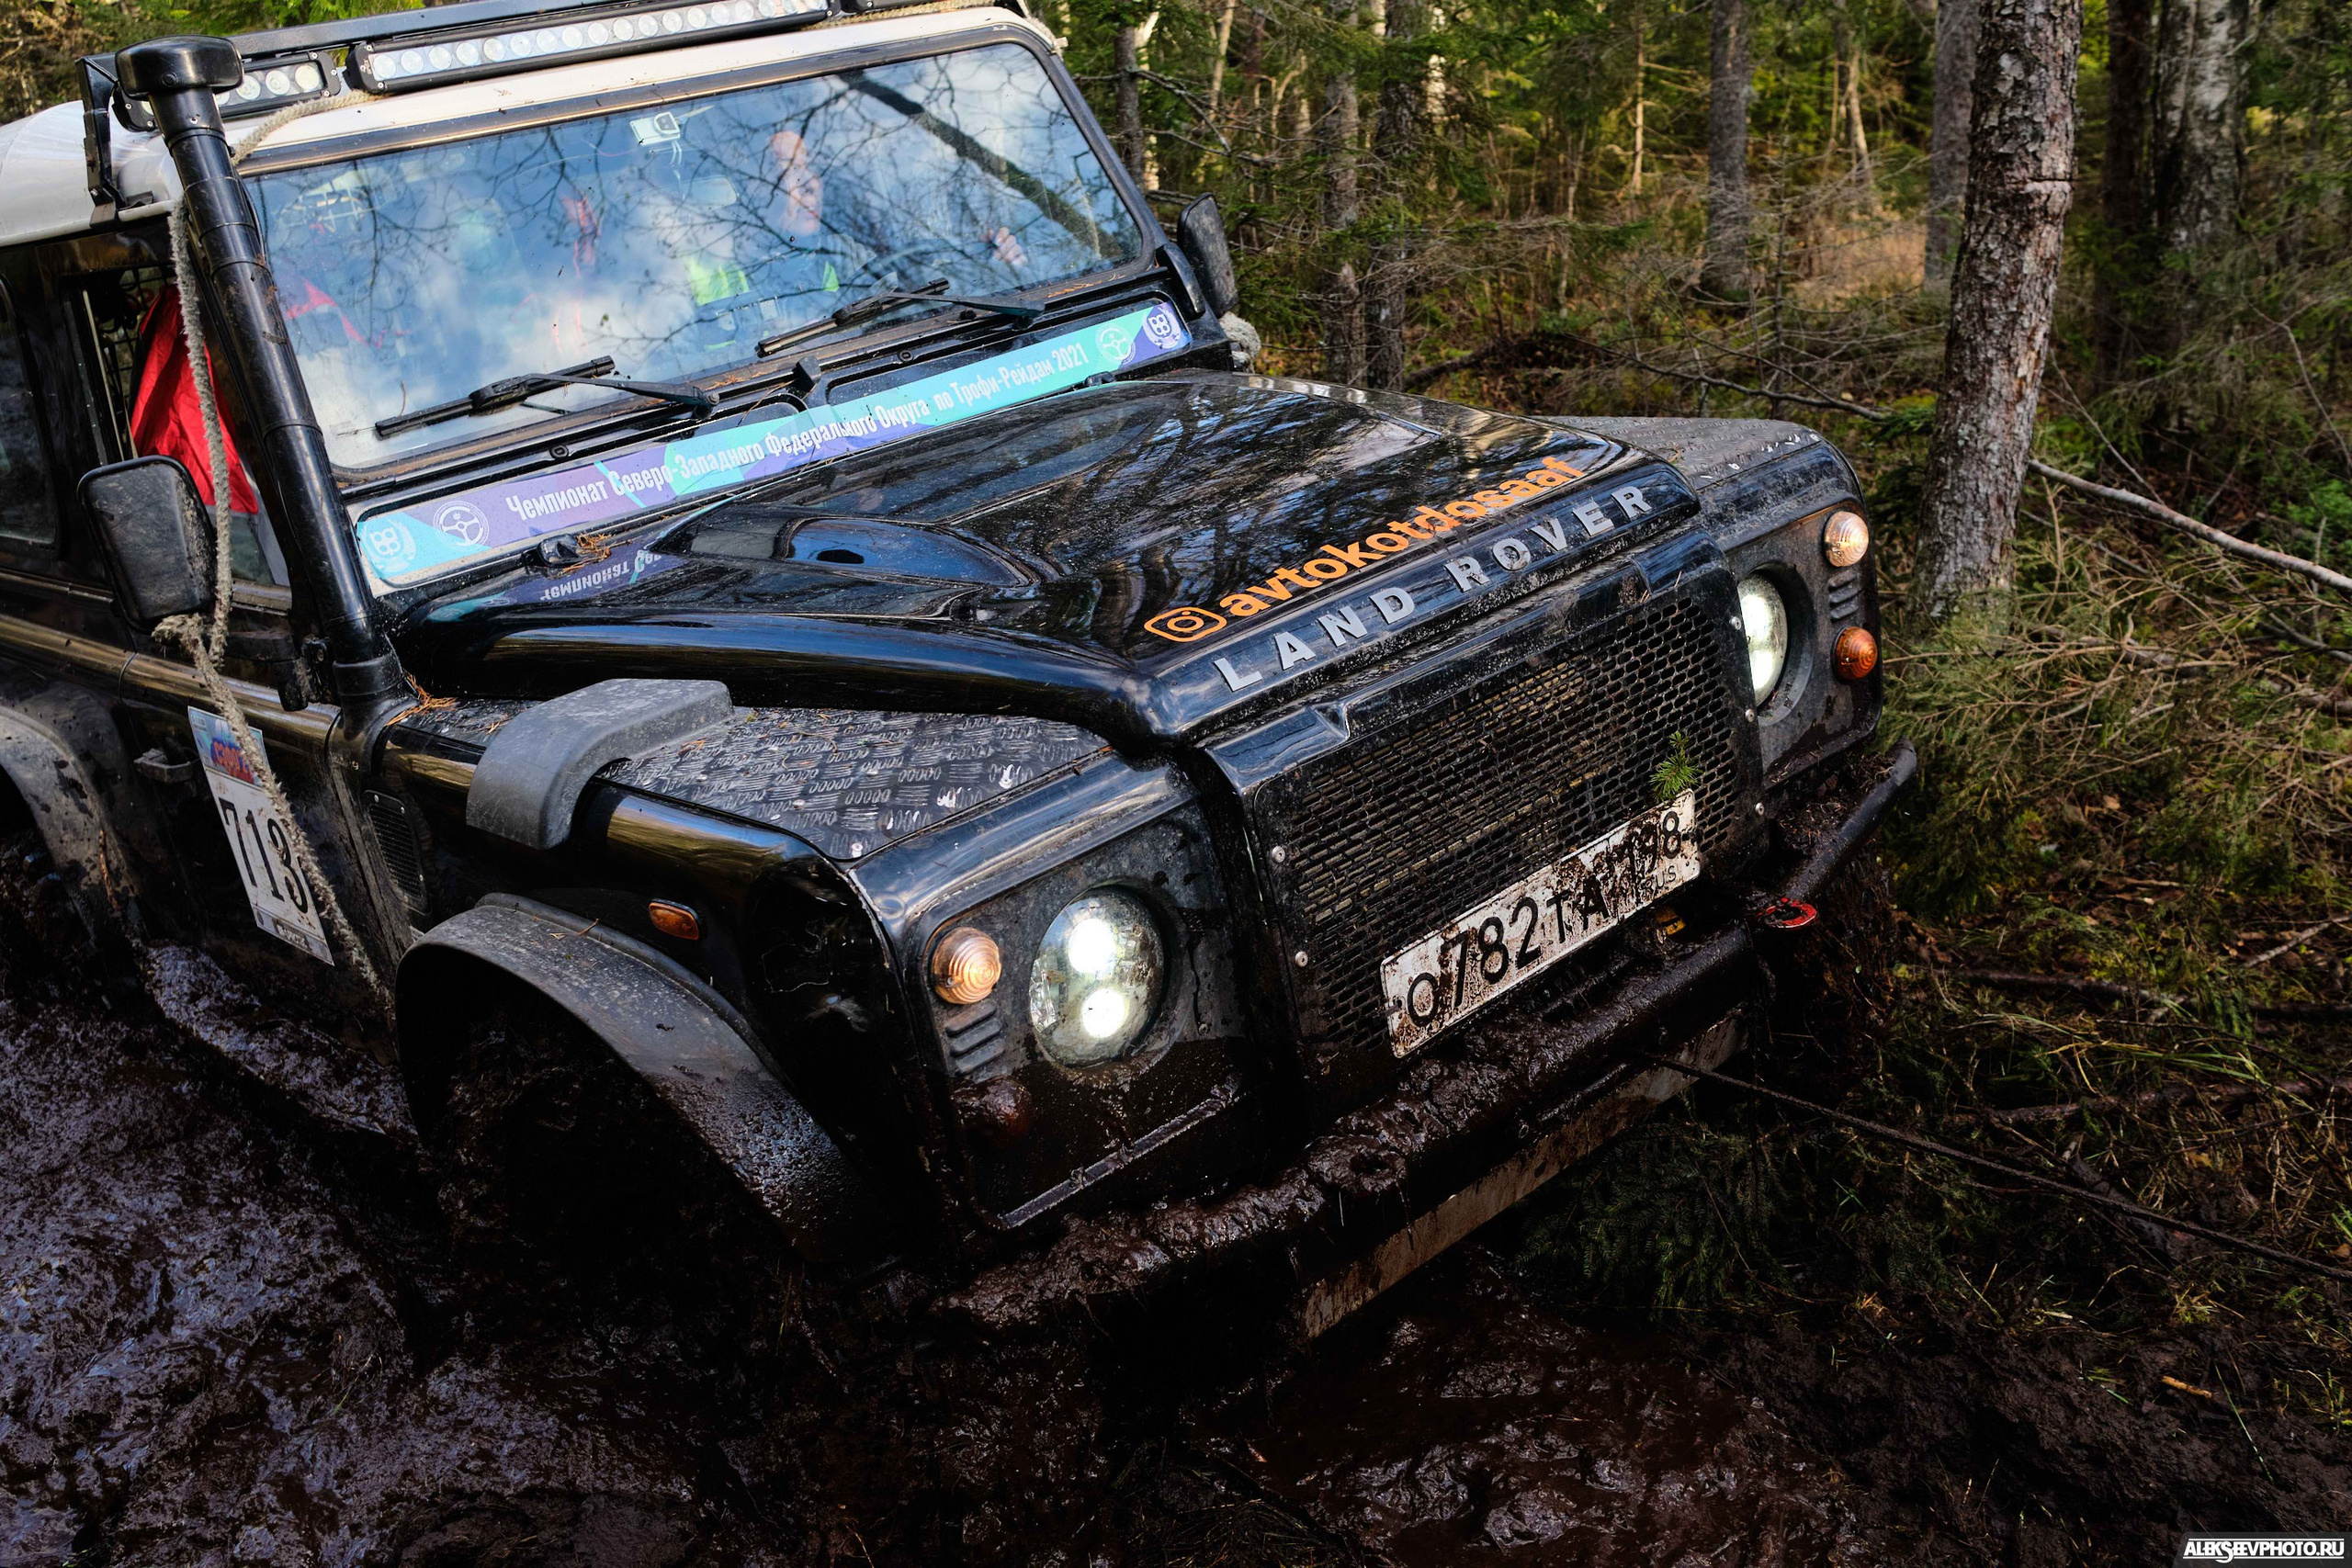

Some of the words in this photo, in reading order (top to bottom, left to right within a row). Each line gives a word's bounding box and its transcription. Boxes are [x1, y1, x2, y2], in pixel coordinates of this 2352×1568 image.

[505, 480, 608, 522] Чемпионат
[609, 441, 765, 497] Северо-Западного
[764, 413, 877, 457] Федерального
[874, 400, 931, 429] Округа
[933, 393, 956, 420] по
[952, 358, 1057, 408] Трофи-Рейдам
[1051, 343, 1091, 373] 2021
[1213, 586, 1416, 692] LAND
[1444, 486, 1653, 592] ROVER
[1219, 457, 1588, 617] avtokotdosaaf
[219, 797, 309, 914] 713
